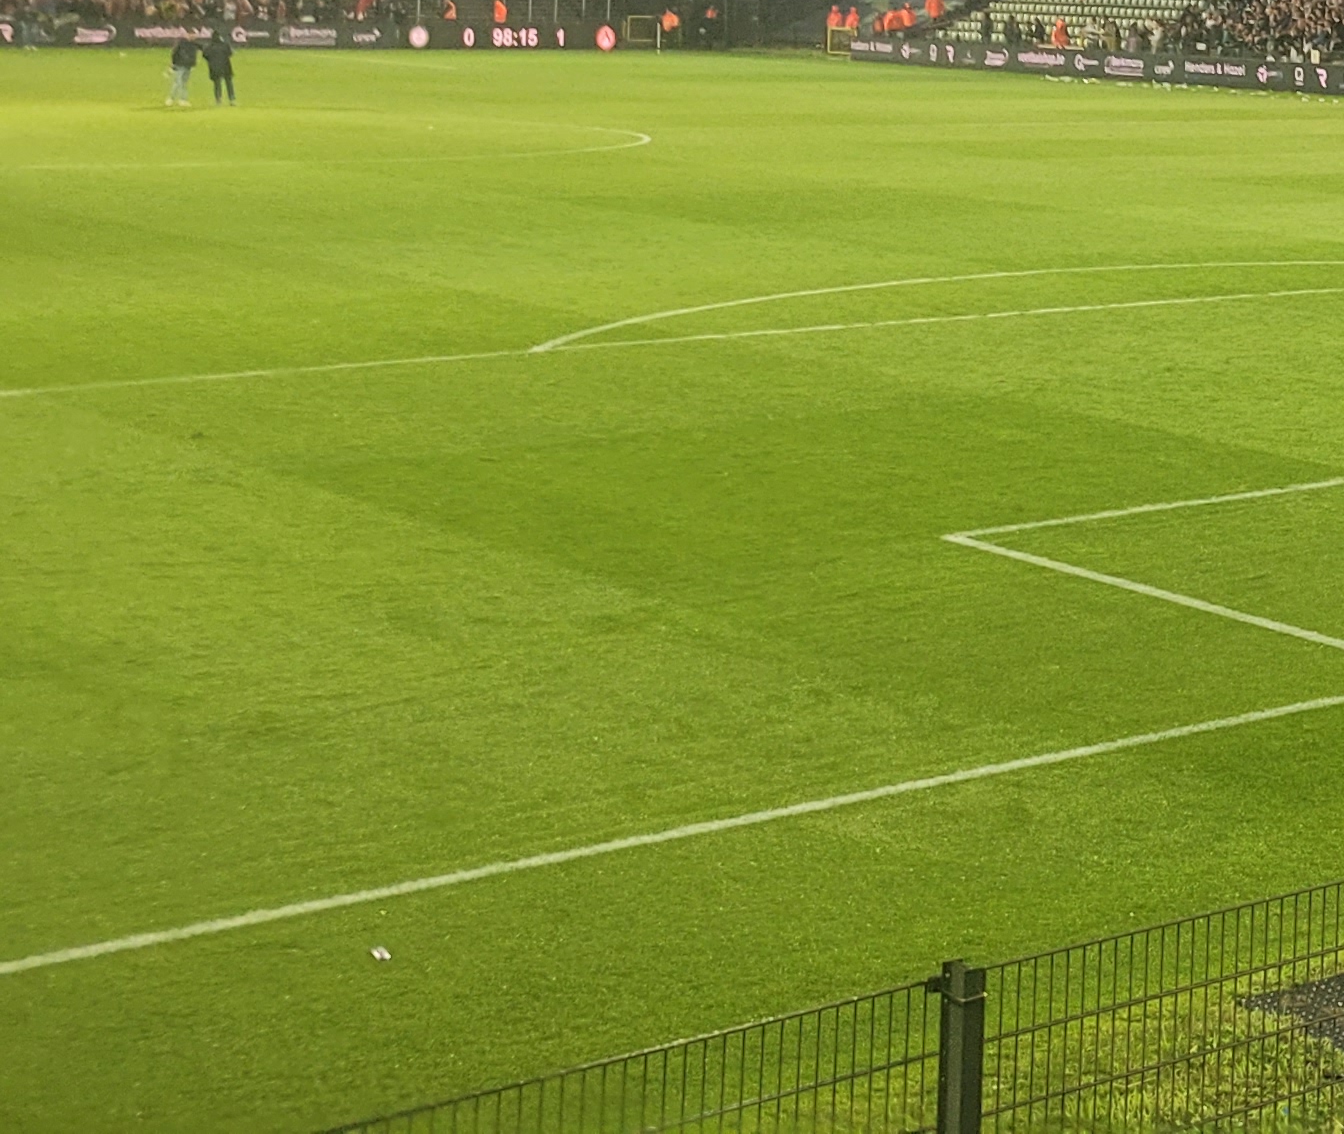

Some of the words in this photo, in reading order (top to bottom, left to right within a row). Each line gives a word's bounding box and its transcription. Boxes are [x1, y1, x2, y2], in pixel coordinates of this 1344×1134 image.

[462, 27, 475, 47] 0
[492, 27, 538, 48] 98:15
[556, 28, 566, 47] 1
